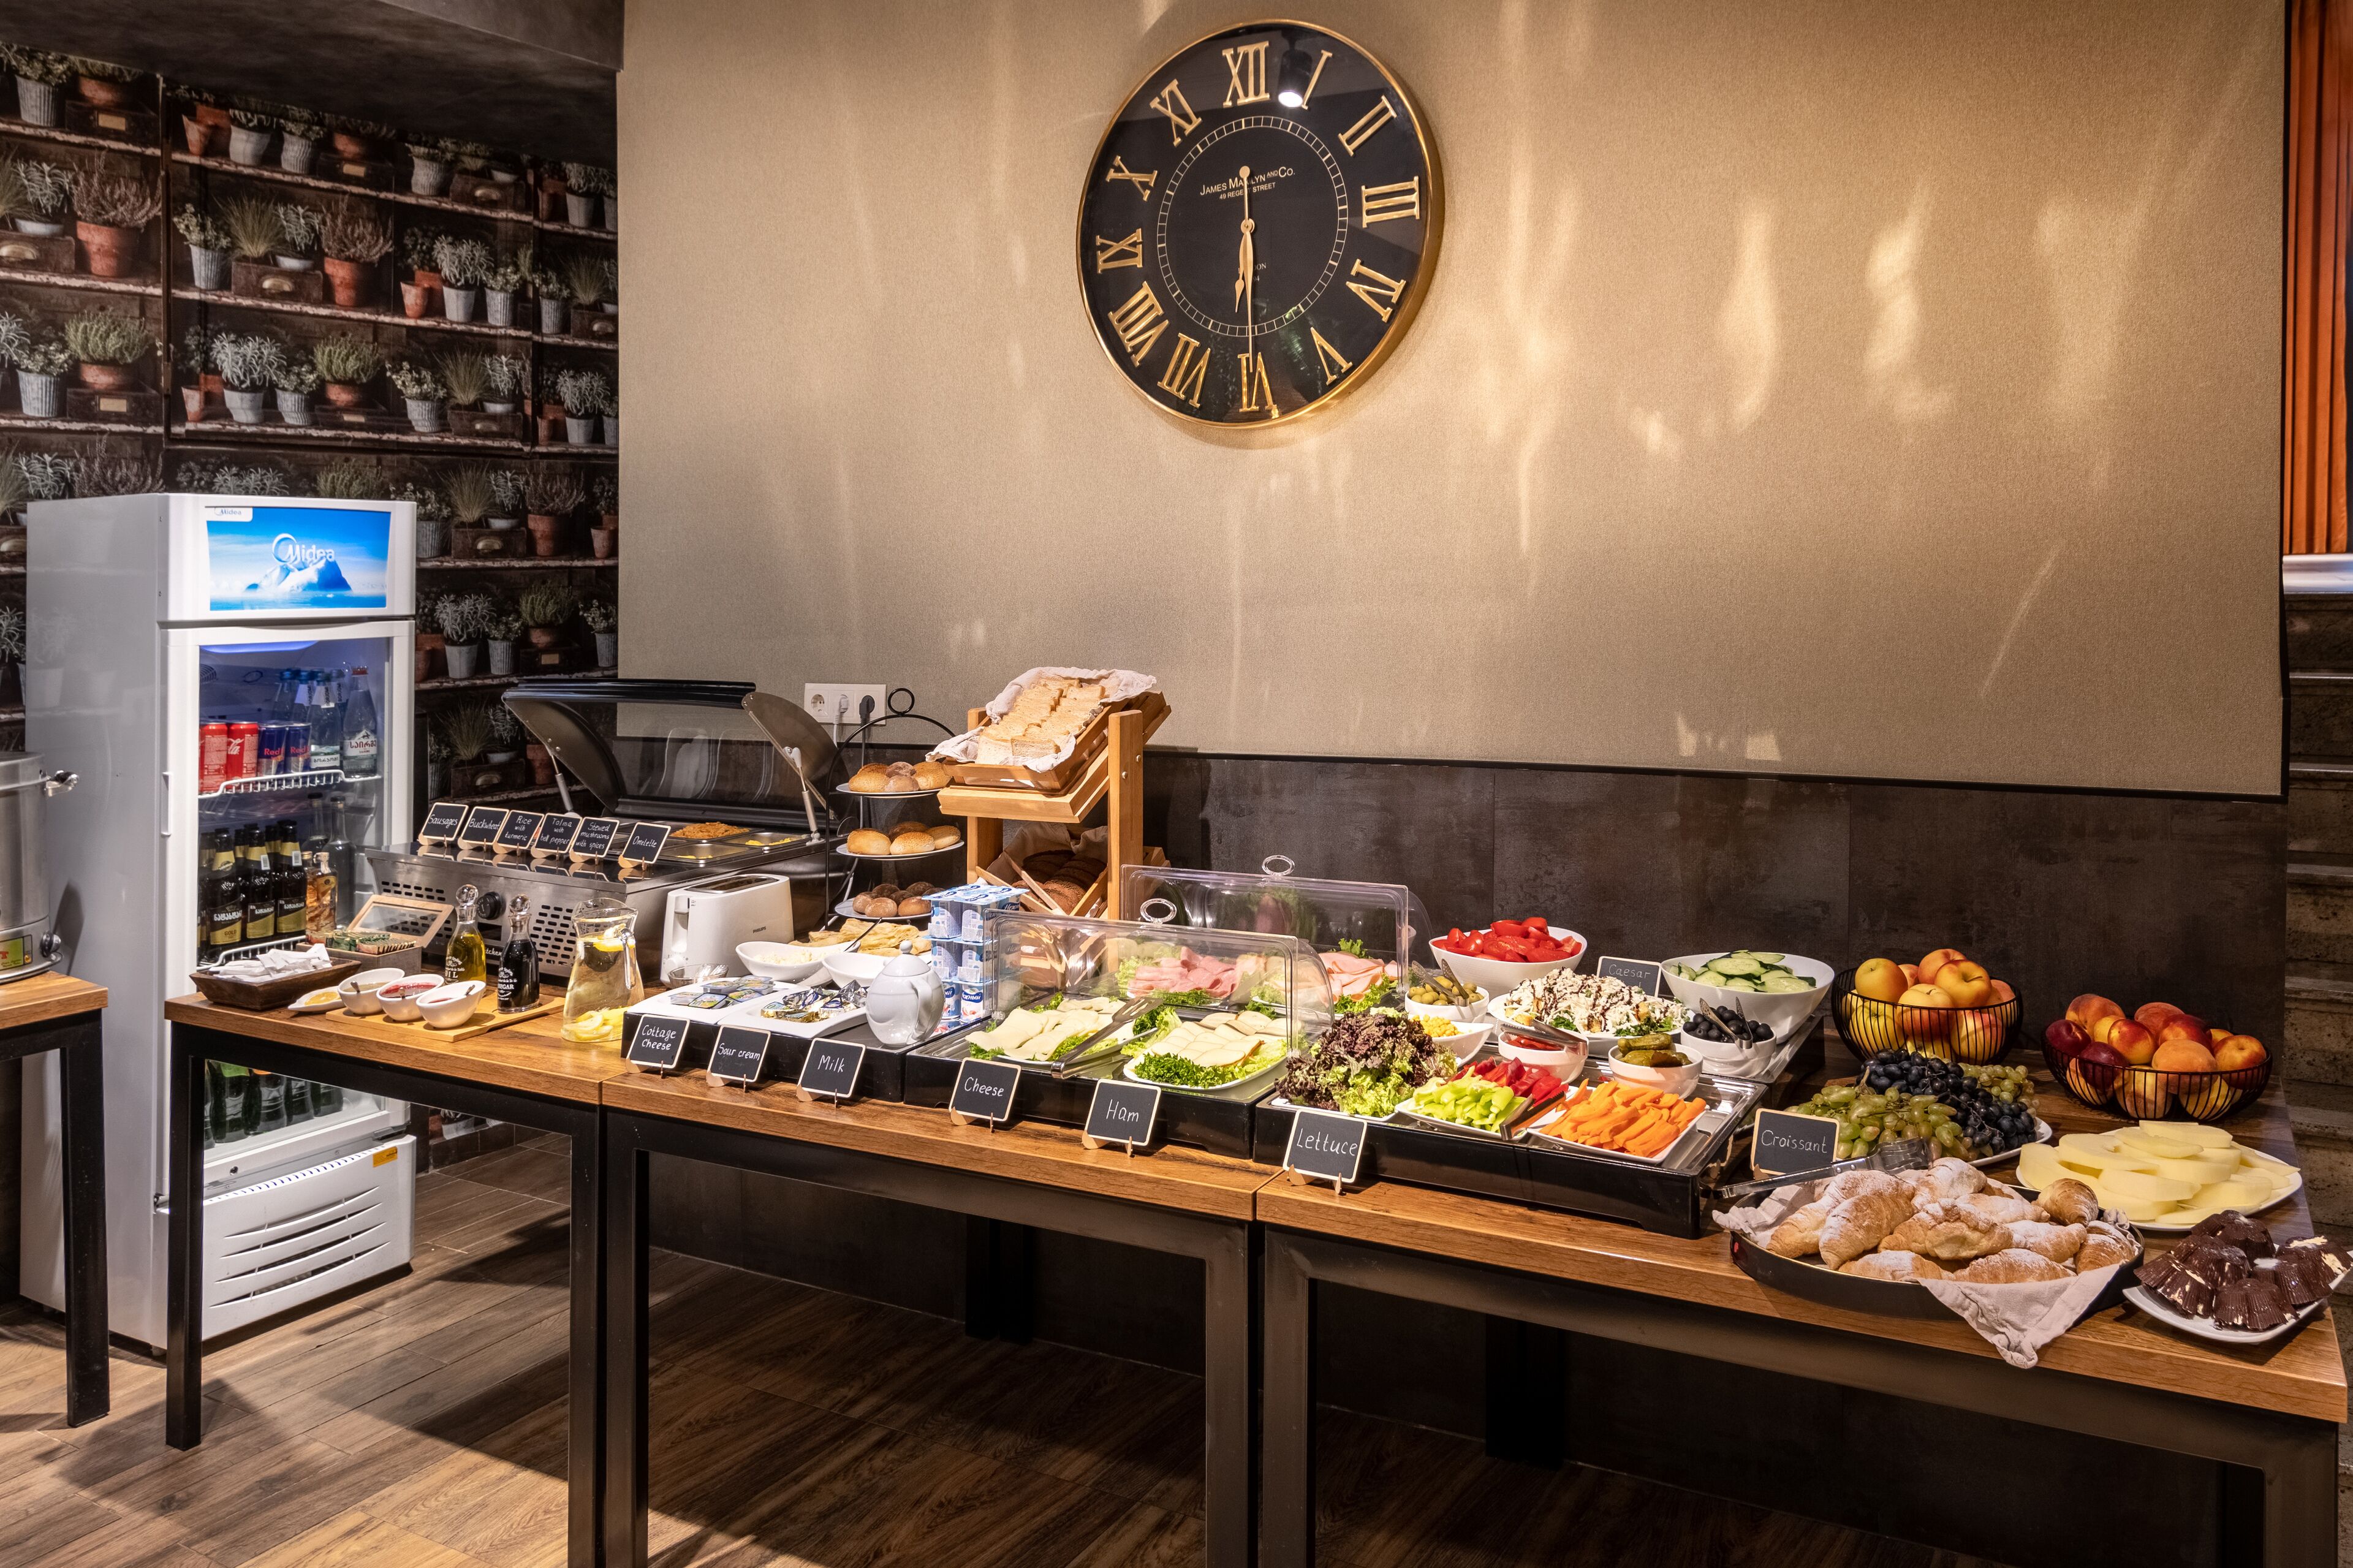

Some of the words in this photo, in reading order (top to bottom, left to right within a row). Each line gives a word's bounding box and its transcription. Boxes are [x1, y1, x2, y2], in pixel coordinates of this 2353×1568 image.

[1222, 40, 1270, 107] XII
[1150, 79, 1202, 146] XI
[1338, 95, 1397, 156] II
[1105, 155, 1159, 202] X
[1200, 183, 1227, 195] JAMES
[1267, 170, 1278, 178] AND
[1227, 187, 1252, 199] REGET
[1252, 182, 1276, 192] STREET
[1361, 175, 1420, 228] III
[1096, 228, 1143, 274] IX
[1346, 259, 1406, 323] IV
[1107, 281, 1170, 367] VIII
[1310, 327, 1353, 385] V
[1158, 332, 1211, 409] VII
[1238, 351, 1278, 413] VI
[282, 542, 335, 564] Midea
[290, 745, 306, 754] Red
[428, 814, 458, 829] Sausages
[468, 818, 501, 831] Buckwheat
[516, 815, 532, 825] Rice
[552, 818, 572, 827] Tolma
[588, 822, 610, 832] Stewed
[504, 833, 528, 841] turmeric
[540, 833, 548, 843] bell
[549, 836, 570, 846] pepper
[580, 830, 610, 839] mushrooms
[589, 841, 605, 850] spices
[1608, 964, 1651, 979] Caesar
[642, 1025, 676, 1042] Cottage
[718, 1042, 737, 1056] Sour
[738, 1049, 761, 1061] cream
[817, 1054, 846, 1074] Milk
[963, 1076, 1004, 1097] Cheese
[1105, 1098, 1140, 1123] Ham
[1296, 1127, 1358, 1156] Lettuce
[1760, 1129, 1828, 1154] Croissant
